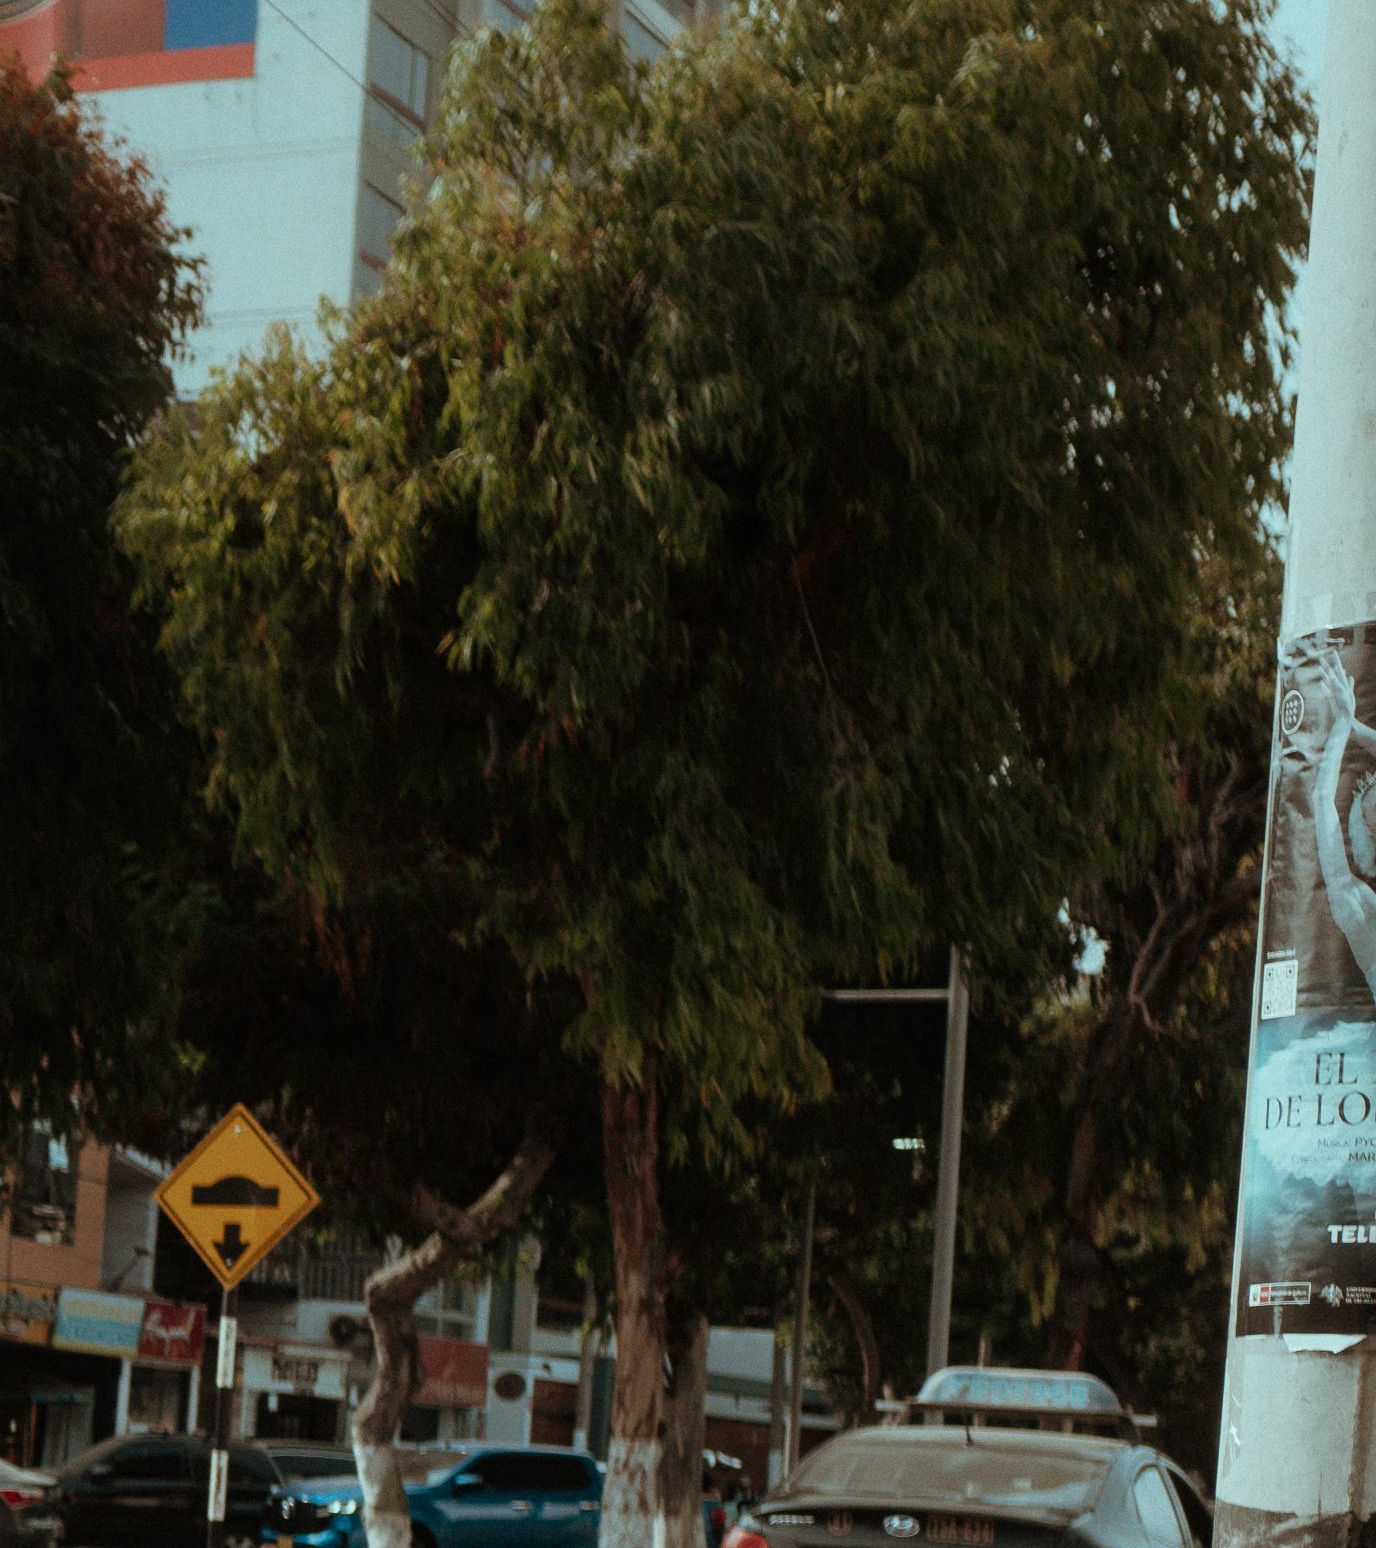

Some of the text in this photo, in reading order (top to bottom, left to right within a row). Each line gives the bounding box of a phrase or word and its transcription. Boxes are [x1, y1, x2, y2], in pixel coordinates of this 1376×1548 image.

[1314, 1052, 1358, 1085] EL
[1265, 1090, 1376, 1130] DE LO
